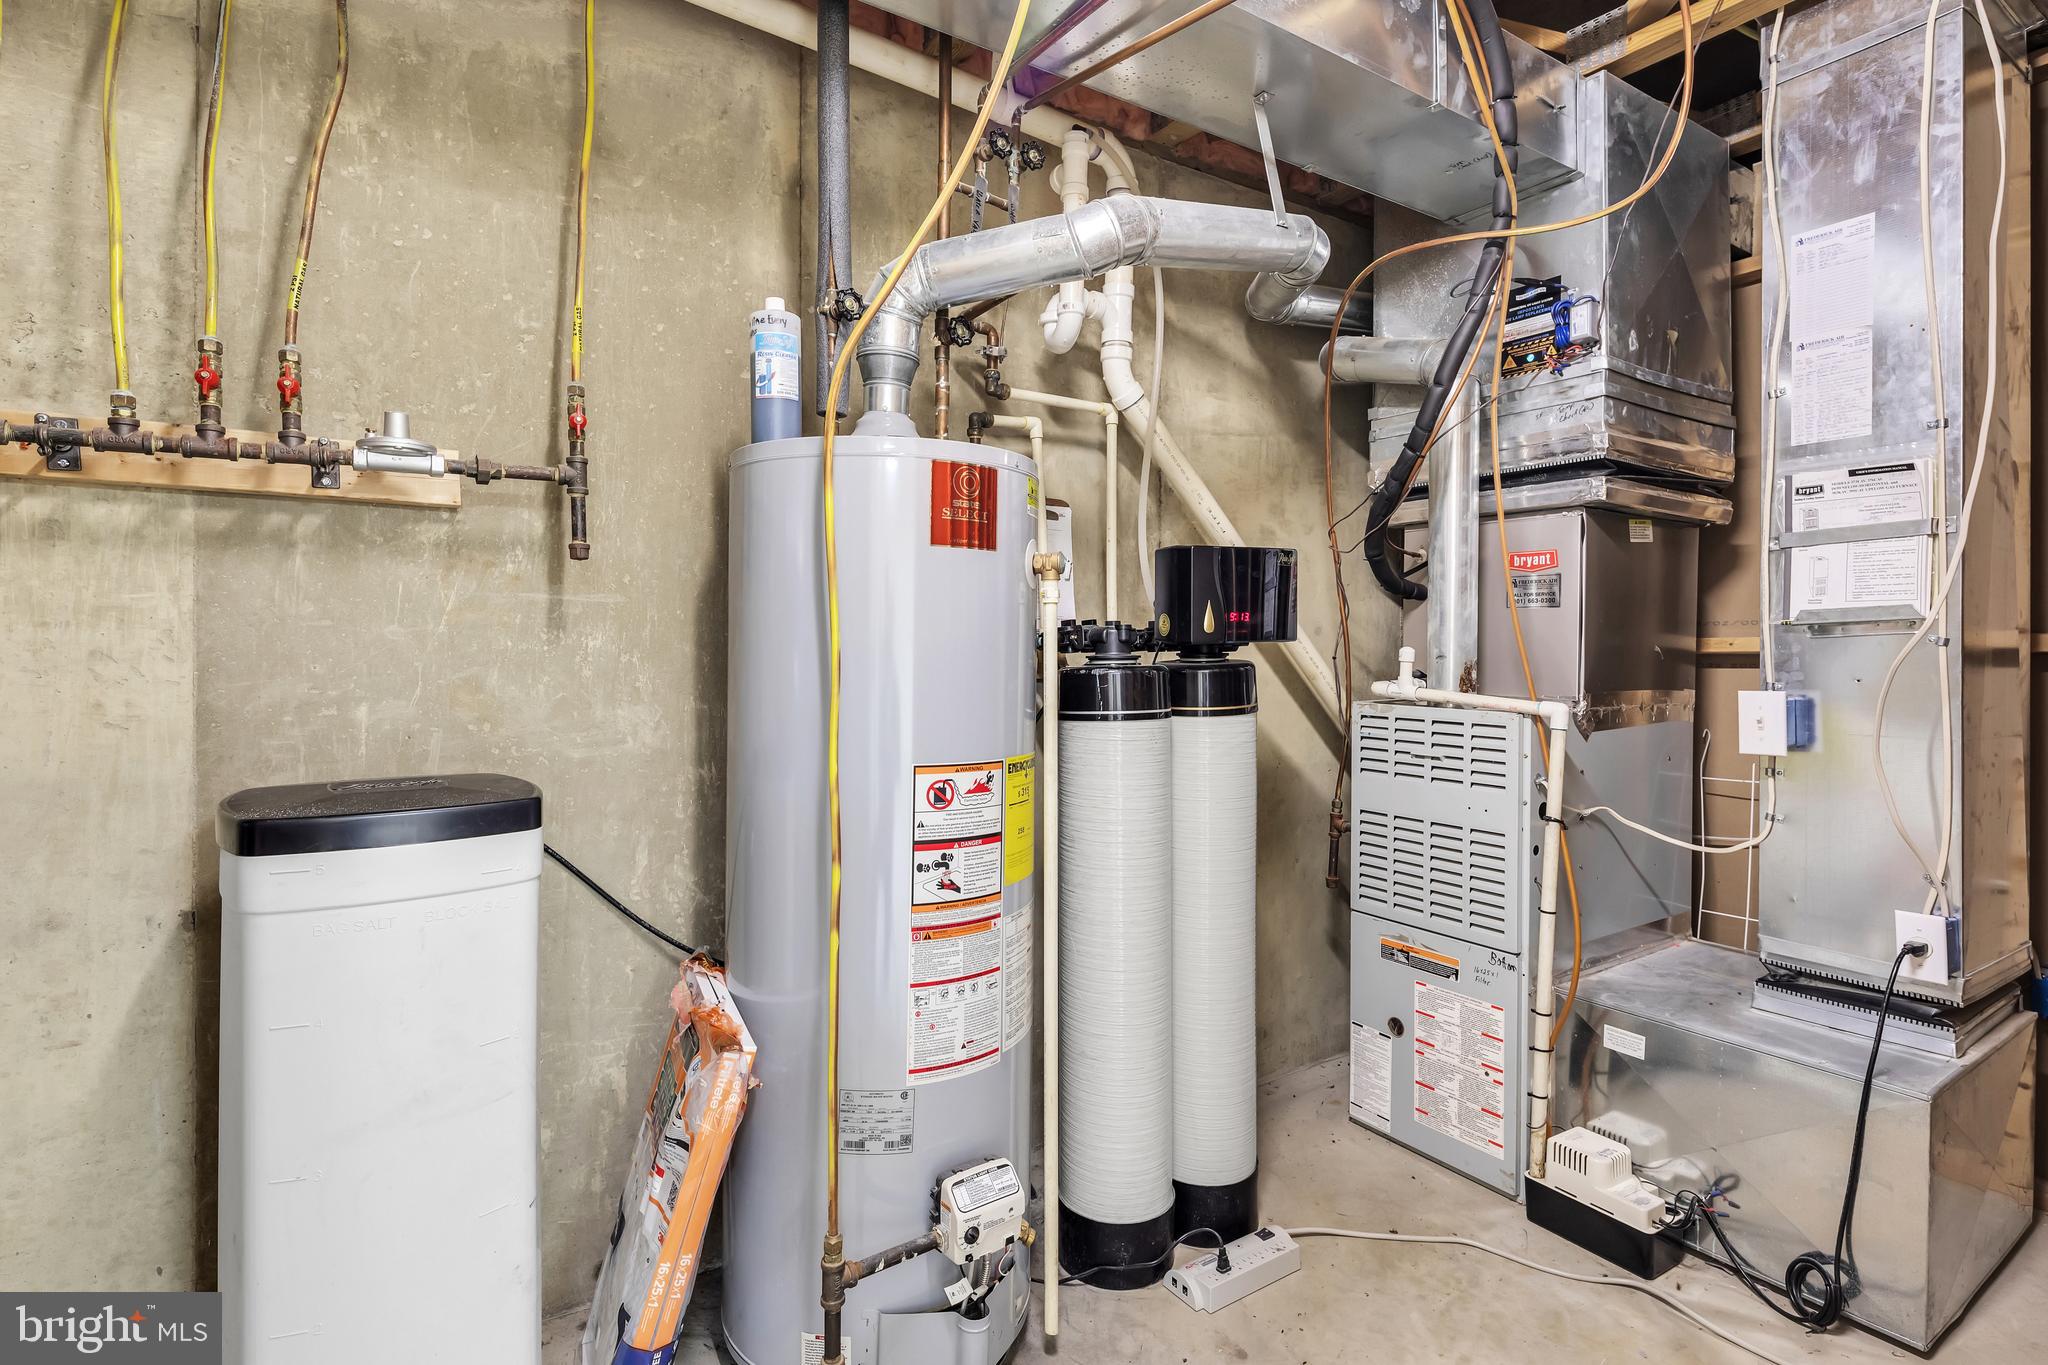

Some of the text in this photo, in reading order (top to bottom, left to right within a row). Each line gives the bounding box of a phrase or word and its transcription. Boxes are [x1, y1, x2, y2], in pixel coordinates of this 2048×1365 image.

[293, 262, 308, 310] NATURAL GAS
[1798, 485, 1822, 495] bryant
[952, 499, 980, 509] state
[941, 507, 988, 521] SELECT
[1513, 553, 1551, 568] bryant
[959, 765, 984, 773] WARNING
[960, 839, 983, 848] DANGER
